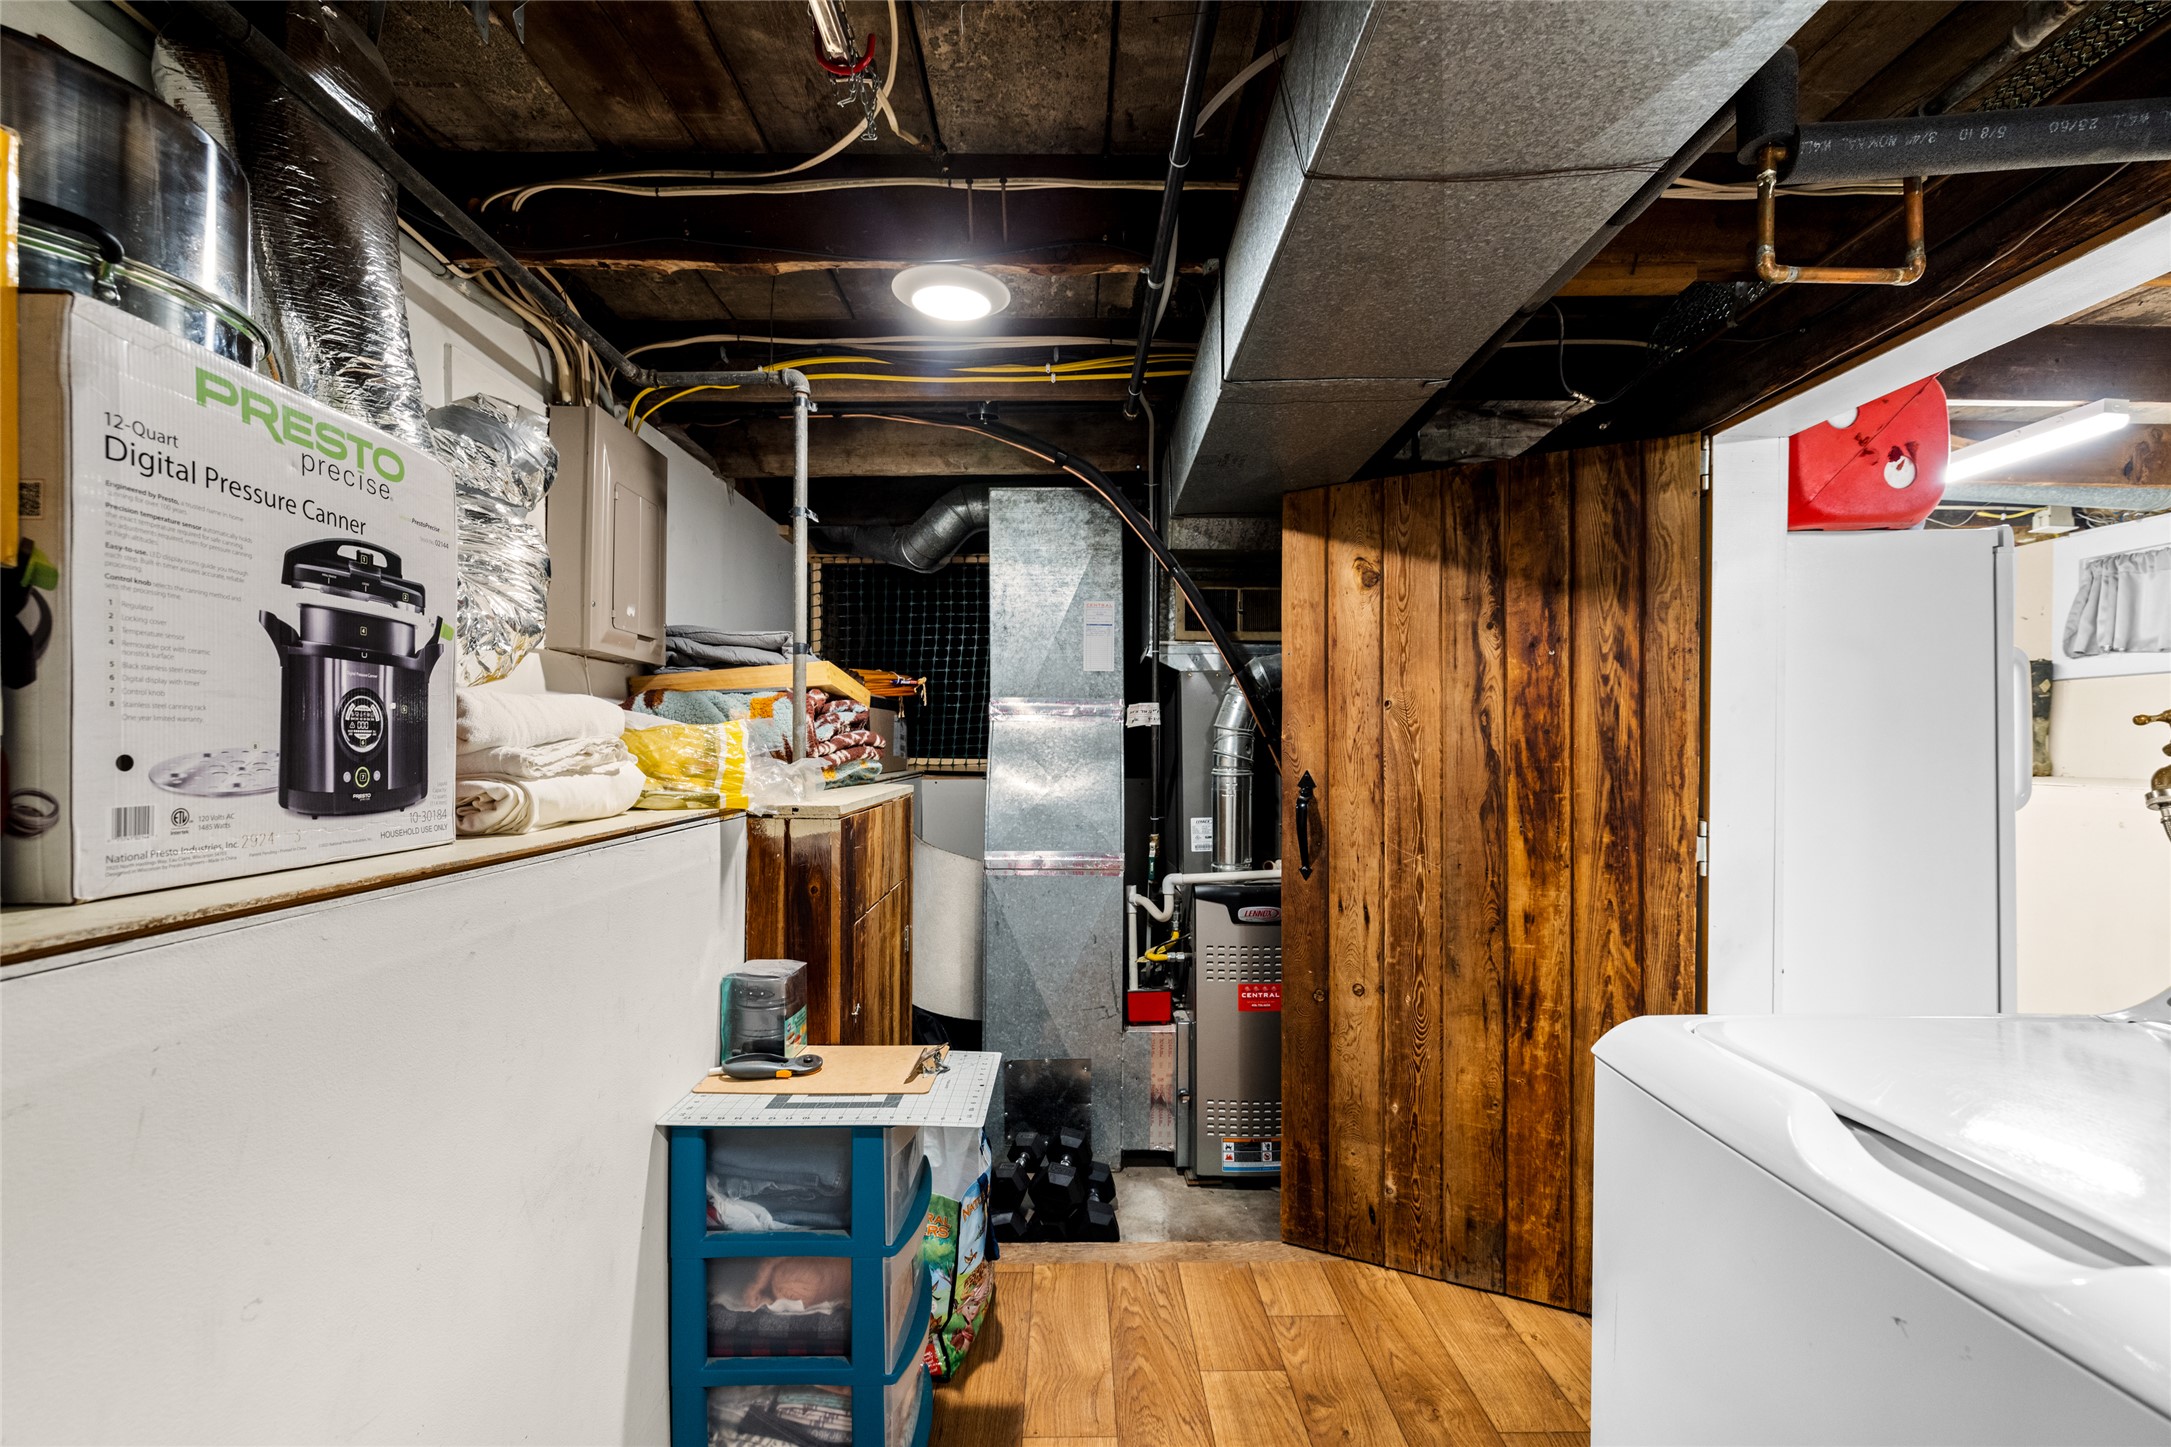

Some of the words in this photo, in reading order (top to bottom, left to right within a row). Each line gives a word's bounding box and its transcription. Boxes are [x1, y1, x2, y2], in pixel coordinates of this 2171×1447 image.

[104, 412, 180, 449] 12-Quart
[195, 366, 405, 483] PRESTO
[300, 452, 391, 502] precise
[105, 435, 196, 485] Digital
[205, 466, 297, 515] Pressure
[303, 499, 366, 535] Canner
[105, 479, 147, 496] Engineered
[148, 491, 156, 500] by
[105, 502, 139, 515] Precision
[140, 510, 181, 526] temperature
[182, 521, 202, 531] sensor
[104, 572, 133, 584] Control
[134, 576, 152, 586] knob
[108, 598, 113, 606] 1
[121, 600, 154, 612] Regulator
[108, 612, 114, 620] 2
[121, 614, 148, 625] Locking
[149, 618, 167, 627] cover
[108, 625, 114, 633] 3
[122, 626, 164, 639] Temperature
[164, 632, 185, 641] sensor
[108, 638, 115, 646] 4
[122, 640, 159, 650] Removable
[173, 645, 187, 654] with
[187, 647, 211, 656] ceramic
[121, 649, 149, 658] nonstick
[151, 652, 175, 660] surface
[109, 660, 115, 668] 5
[122, 662, 139, 670] Black
[140, 664, 168, 673] stainless
[168, 665, 184, 673] steel
[184, 667, 208, 675] exterior
[108, 673, 115, 681] 6
[122, 674, 144, 684] Digital
[145, 675, 168, 686] display
[169, 678, 184, 686] with
[184, 679, 201, 687] timer
[122, 688, 147, 696] Control
[148, 689, 166, 697] knob
[108, 700, 115, 708] 8
[122, 701, 151, 709] Stainless
[152, 702, 167, 710] steel
[168, 703, 193, 712] canning
[194, 703, 207, 711] rack
[122, 714, 137, 722] One
[153, 714, 176, 723] limited
[211, 814, 225, 822] Volts
[225, 812, 236, 820] AC
[198, 823, 213, 831] 1485
[213, 822, 231, 830] Watts
[380, 827, 420, 840] HOUSEHOLD
[420, 825, 433, 834] USE
[433, 823, 448, 832] ONLY
[105, 850, 149, 864] National
[150, 848, 178, 858] Presto
[225, 841, 240, 849] Inc.
[1244, 909, 1272, 918] LENNOX
